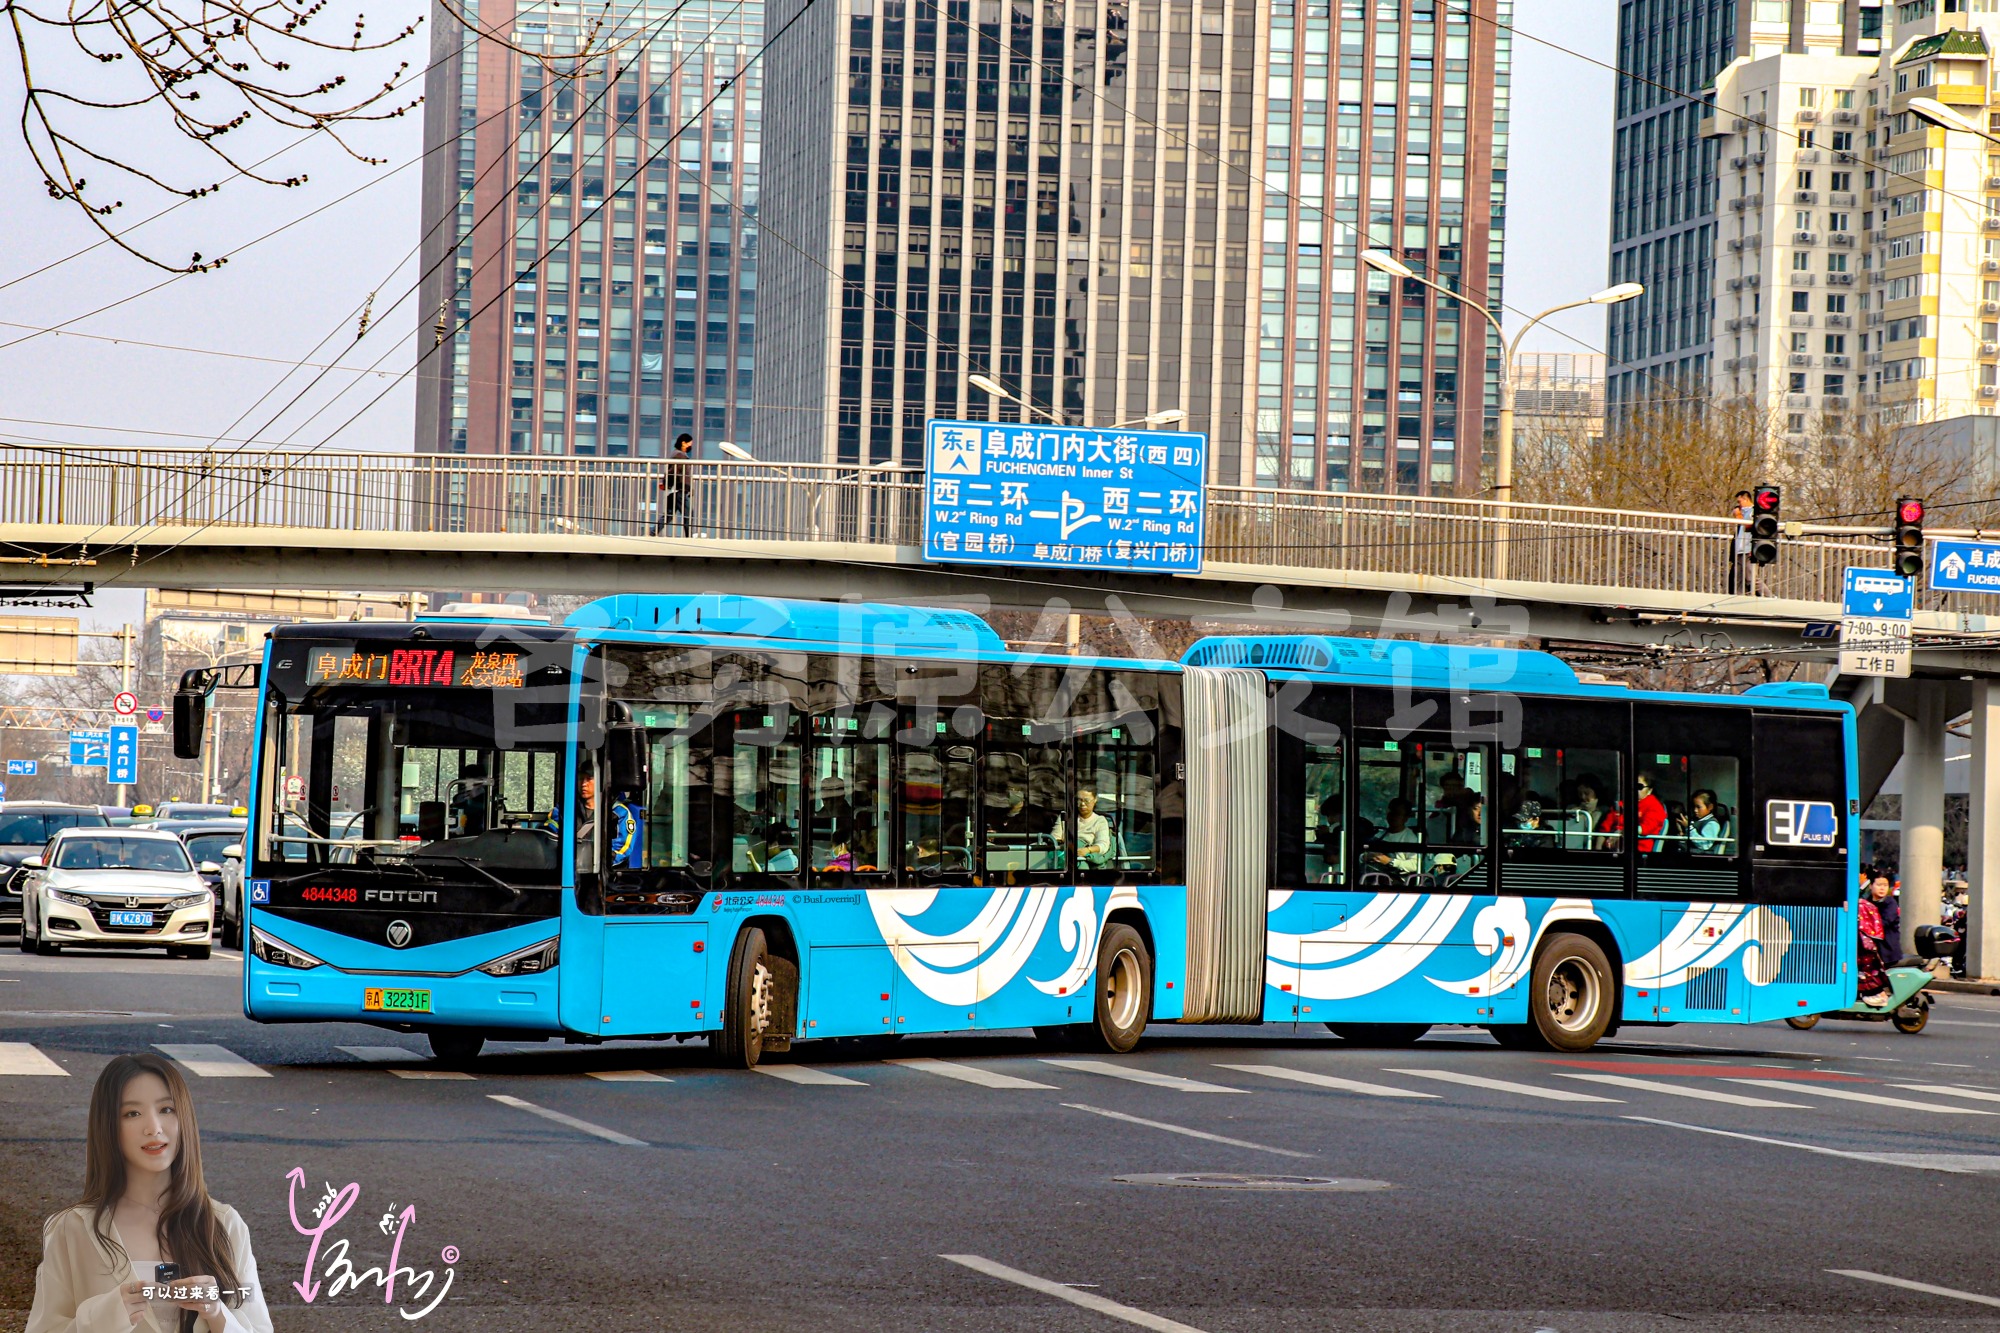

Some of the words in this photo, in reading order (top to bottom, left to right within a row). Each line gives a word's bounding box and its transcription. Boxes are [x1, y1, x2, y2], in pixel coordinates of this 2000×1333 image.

[942, 429, 964, 451] 东
[966, 439, 976, 452] E
[985, 463, 1076, 477] FUCHENGMEN
[1082, 466, 1113, 479] Inner
[1119, 467, 1133, 479] St
[933, 478, 1029, 511] 西二环
[1102, 486, 1198, 519] 西二环
[970, 513, 998, 527] Ring
[1005, 514, 1022, 526] Rd
[1143, 521, 1171, 534] Ring
[1177, 521, 1194, 534] Rd
[1032, 542, 1102, 563] 阜成门桥
[315, 653, 388, 680] 阜成门
[389, 649, 455, 686] BRT4
[470, 652, 519, 671] 龙泉西
[1855, 657, 1895, 672] 工作日
[460, 670, 524, 689] 公交场站
[302, 888, 357, 903] 4844348
[365, 889, 438, 903] FOTON
[724, 895, 754, 906] 北京公交
